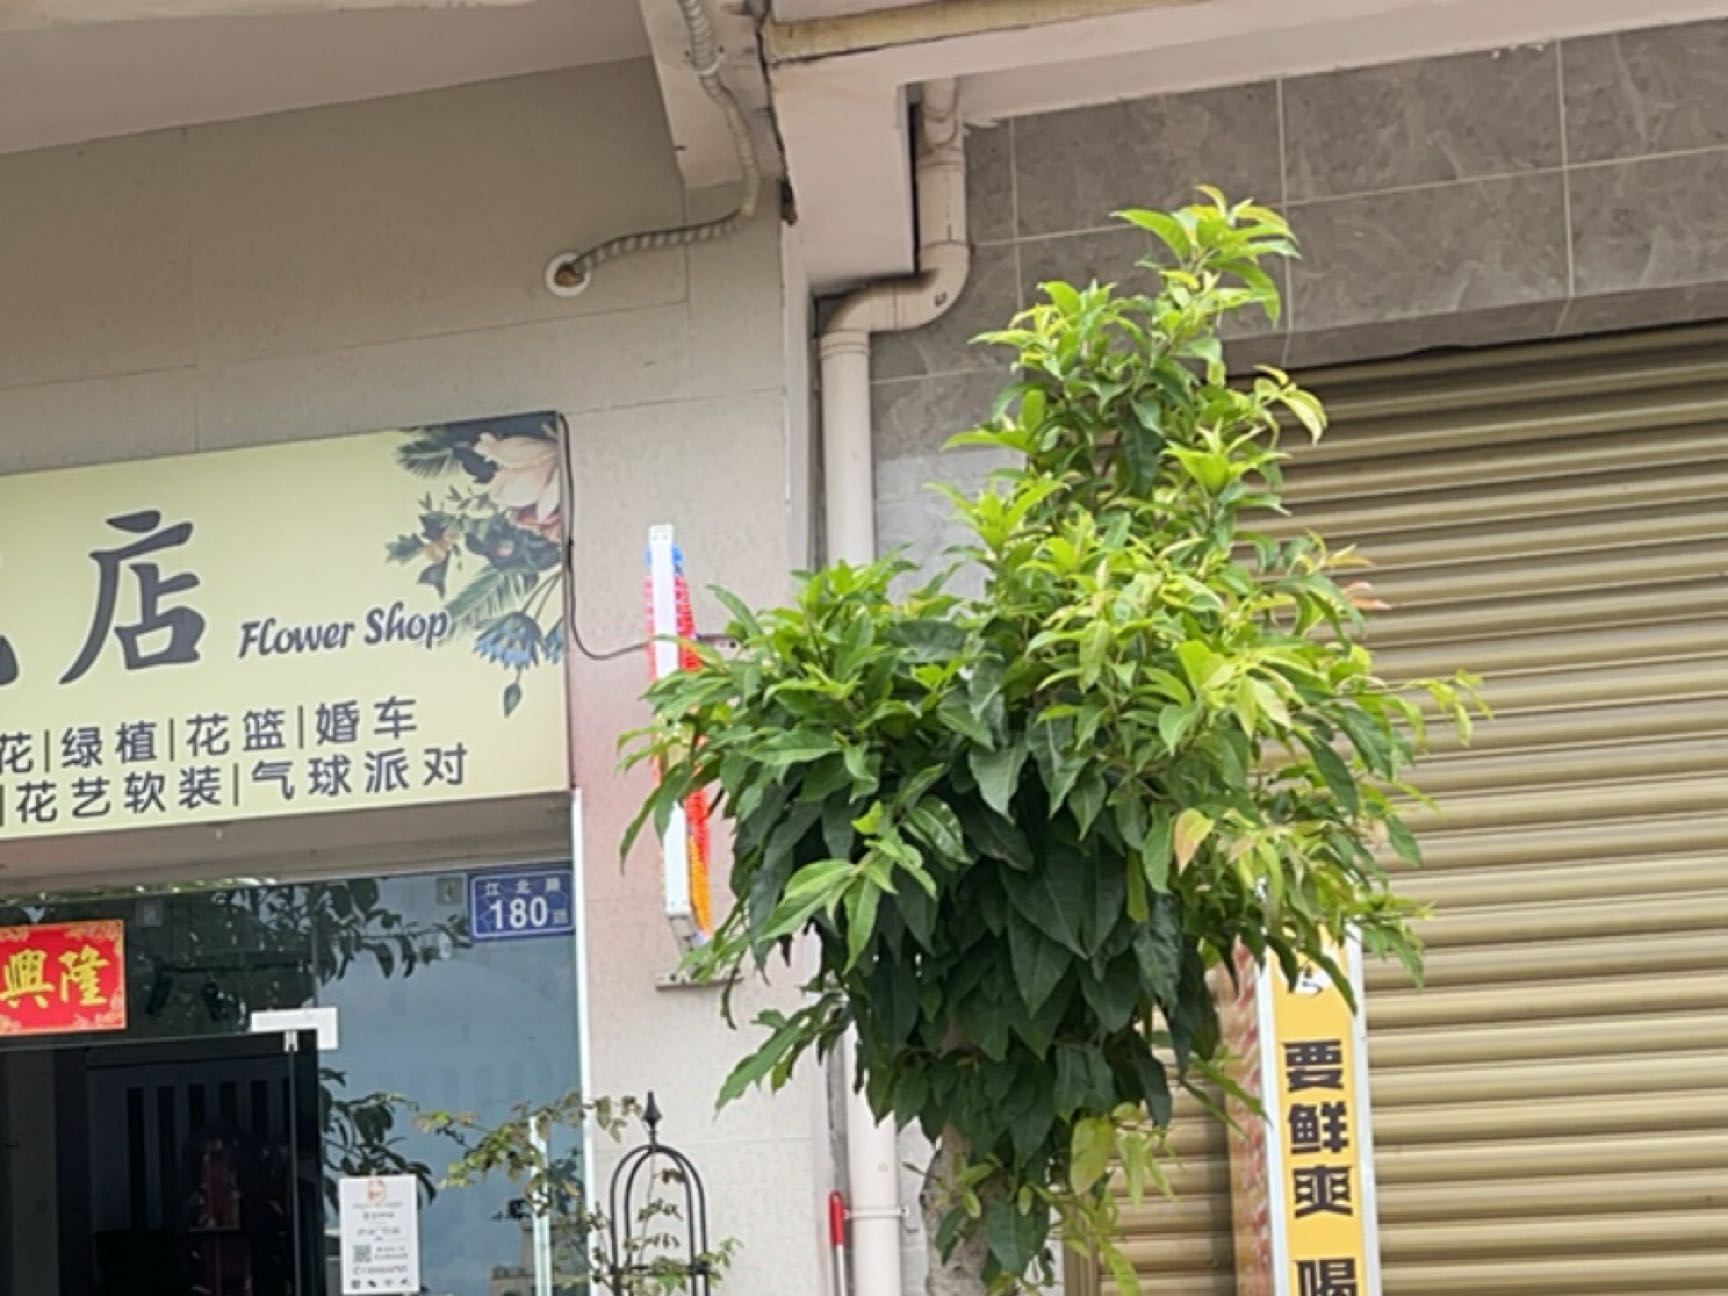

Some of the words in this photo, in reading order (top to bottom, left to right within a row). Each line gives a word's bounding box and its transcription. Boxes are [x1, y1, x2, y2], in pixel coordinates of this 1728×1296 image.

[238, 617, 355, 658] Flower
[364, 600, 449, 650] Shop
[488, 896, 548, 930] 180
[1282, 1038, 1354, 1220] 要鲜爽
